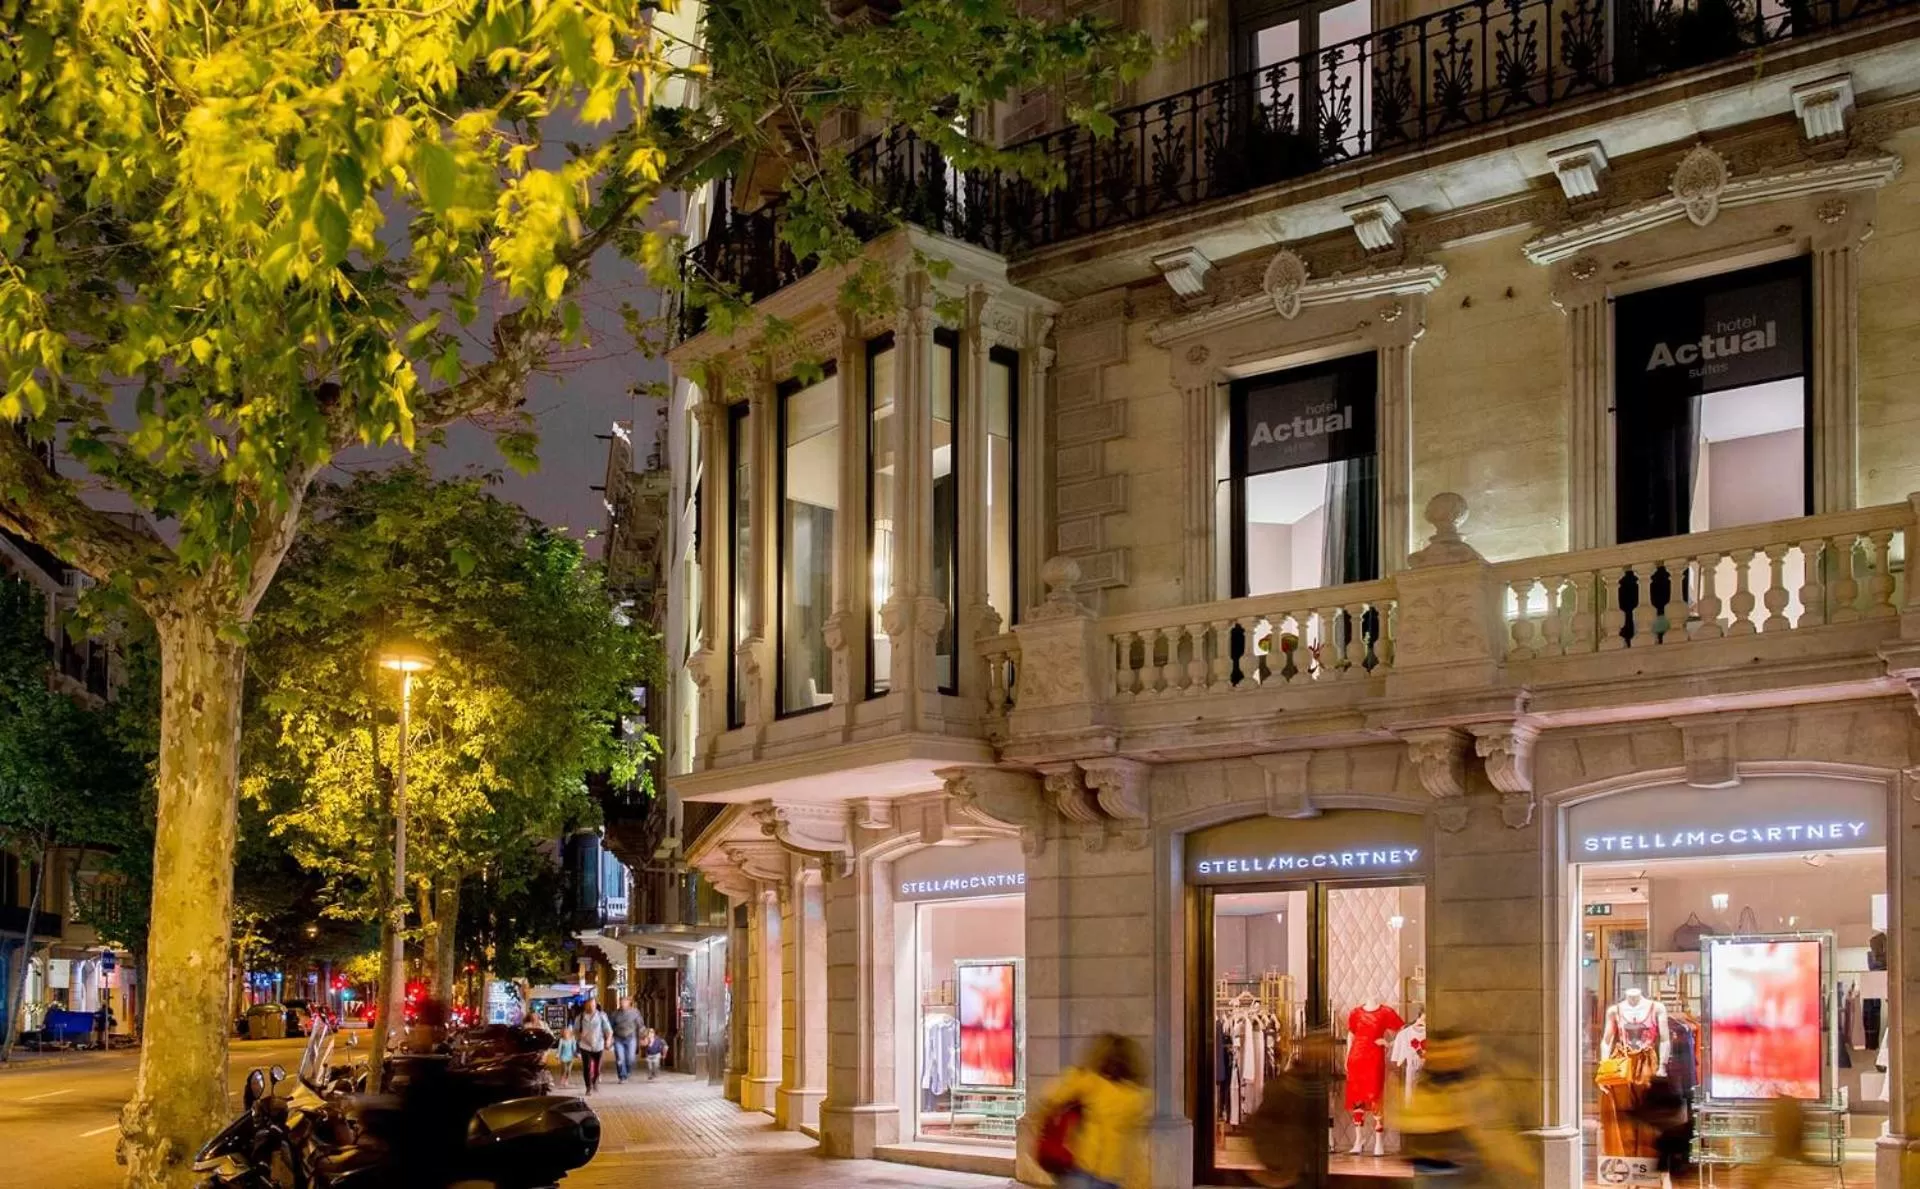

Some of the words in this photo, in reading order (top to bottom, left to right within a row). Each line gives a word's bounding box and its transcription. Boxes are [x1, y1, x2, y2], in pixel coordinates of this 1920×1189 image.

[1717, 314, 1757, 334] hotel
[1646, 320, 1777, 372] Actual
[1305, 398, 1338, 416] hotel
[1250, 404, 1353, 447] Actual
